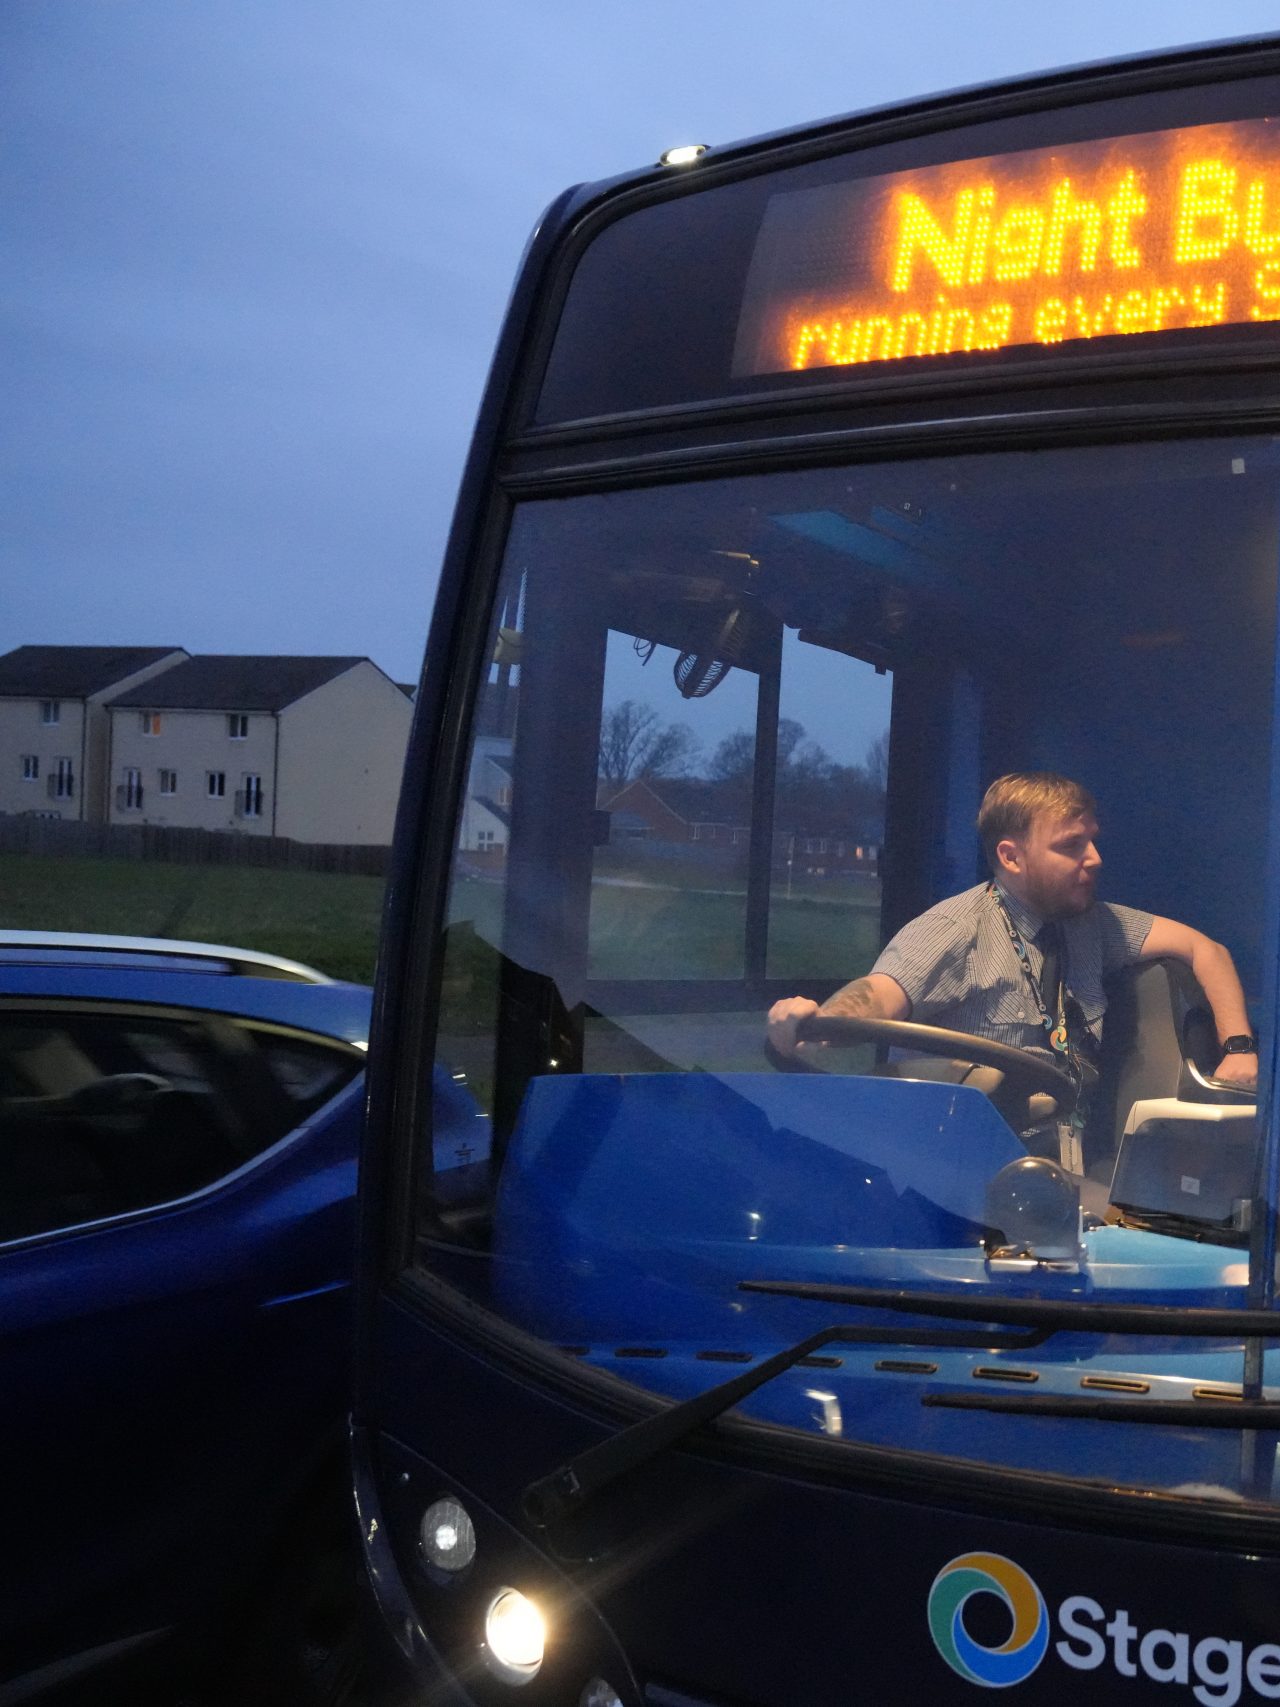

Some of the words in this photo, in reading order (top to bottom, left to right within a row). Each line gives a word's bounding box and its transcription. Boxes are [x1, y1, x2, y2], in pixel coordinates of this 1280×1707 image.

[889, 170, 1148, 292] Night
[794, 293, 1013, 371] running
[1035, 281, 1226, 345] every
